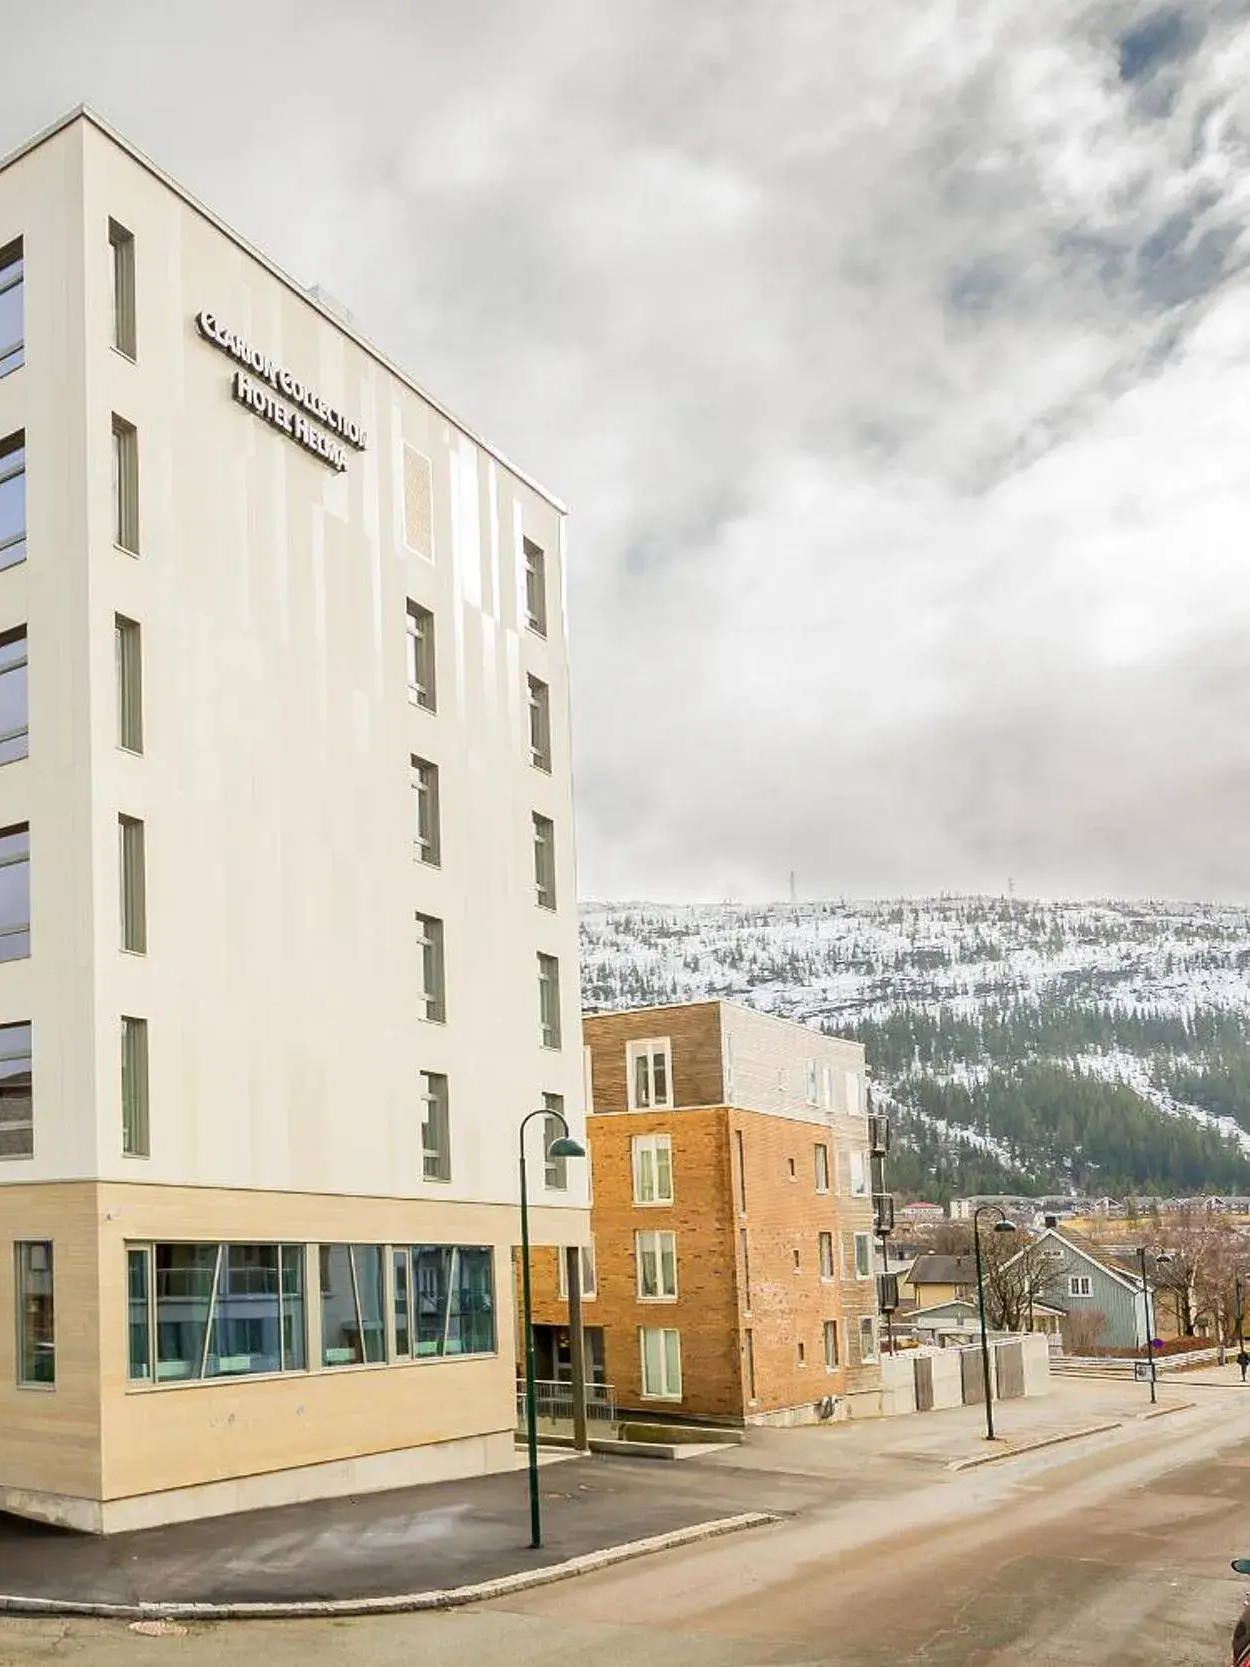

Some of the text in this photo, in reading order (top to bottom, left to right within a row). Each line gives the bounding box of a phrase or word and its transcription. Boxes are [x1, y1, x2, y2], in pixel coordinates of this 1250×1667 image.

[196, 310, 368, 449] CLARION COLLECTION
[232, 371, 350, 472] HOTEL HELMA
